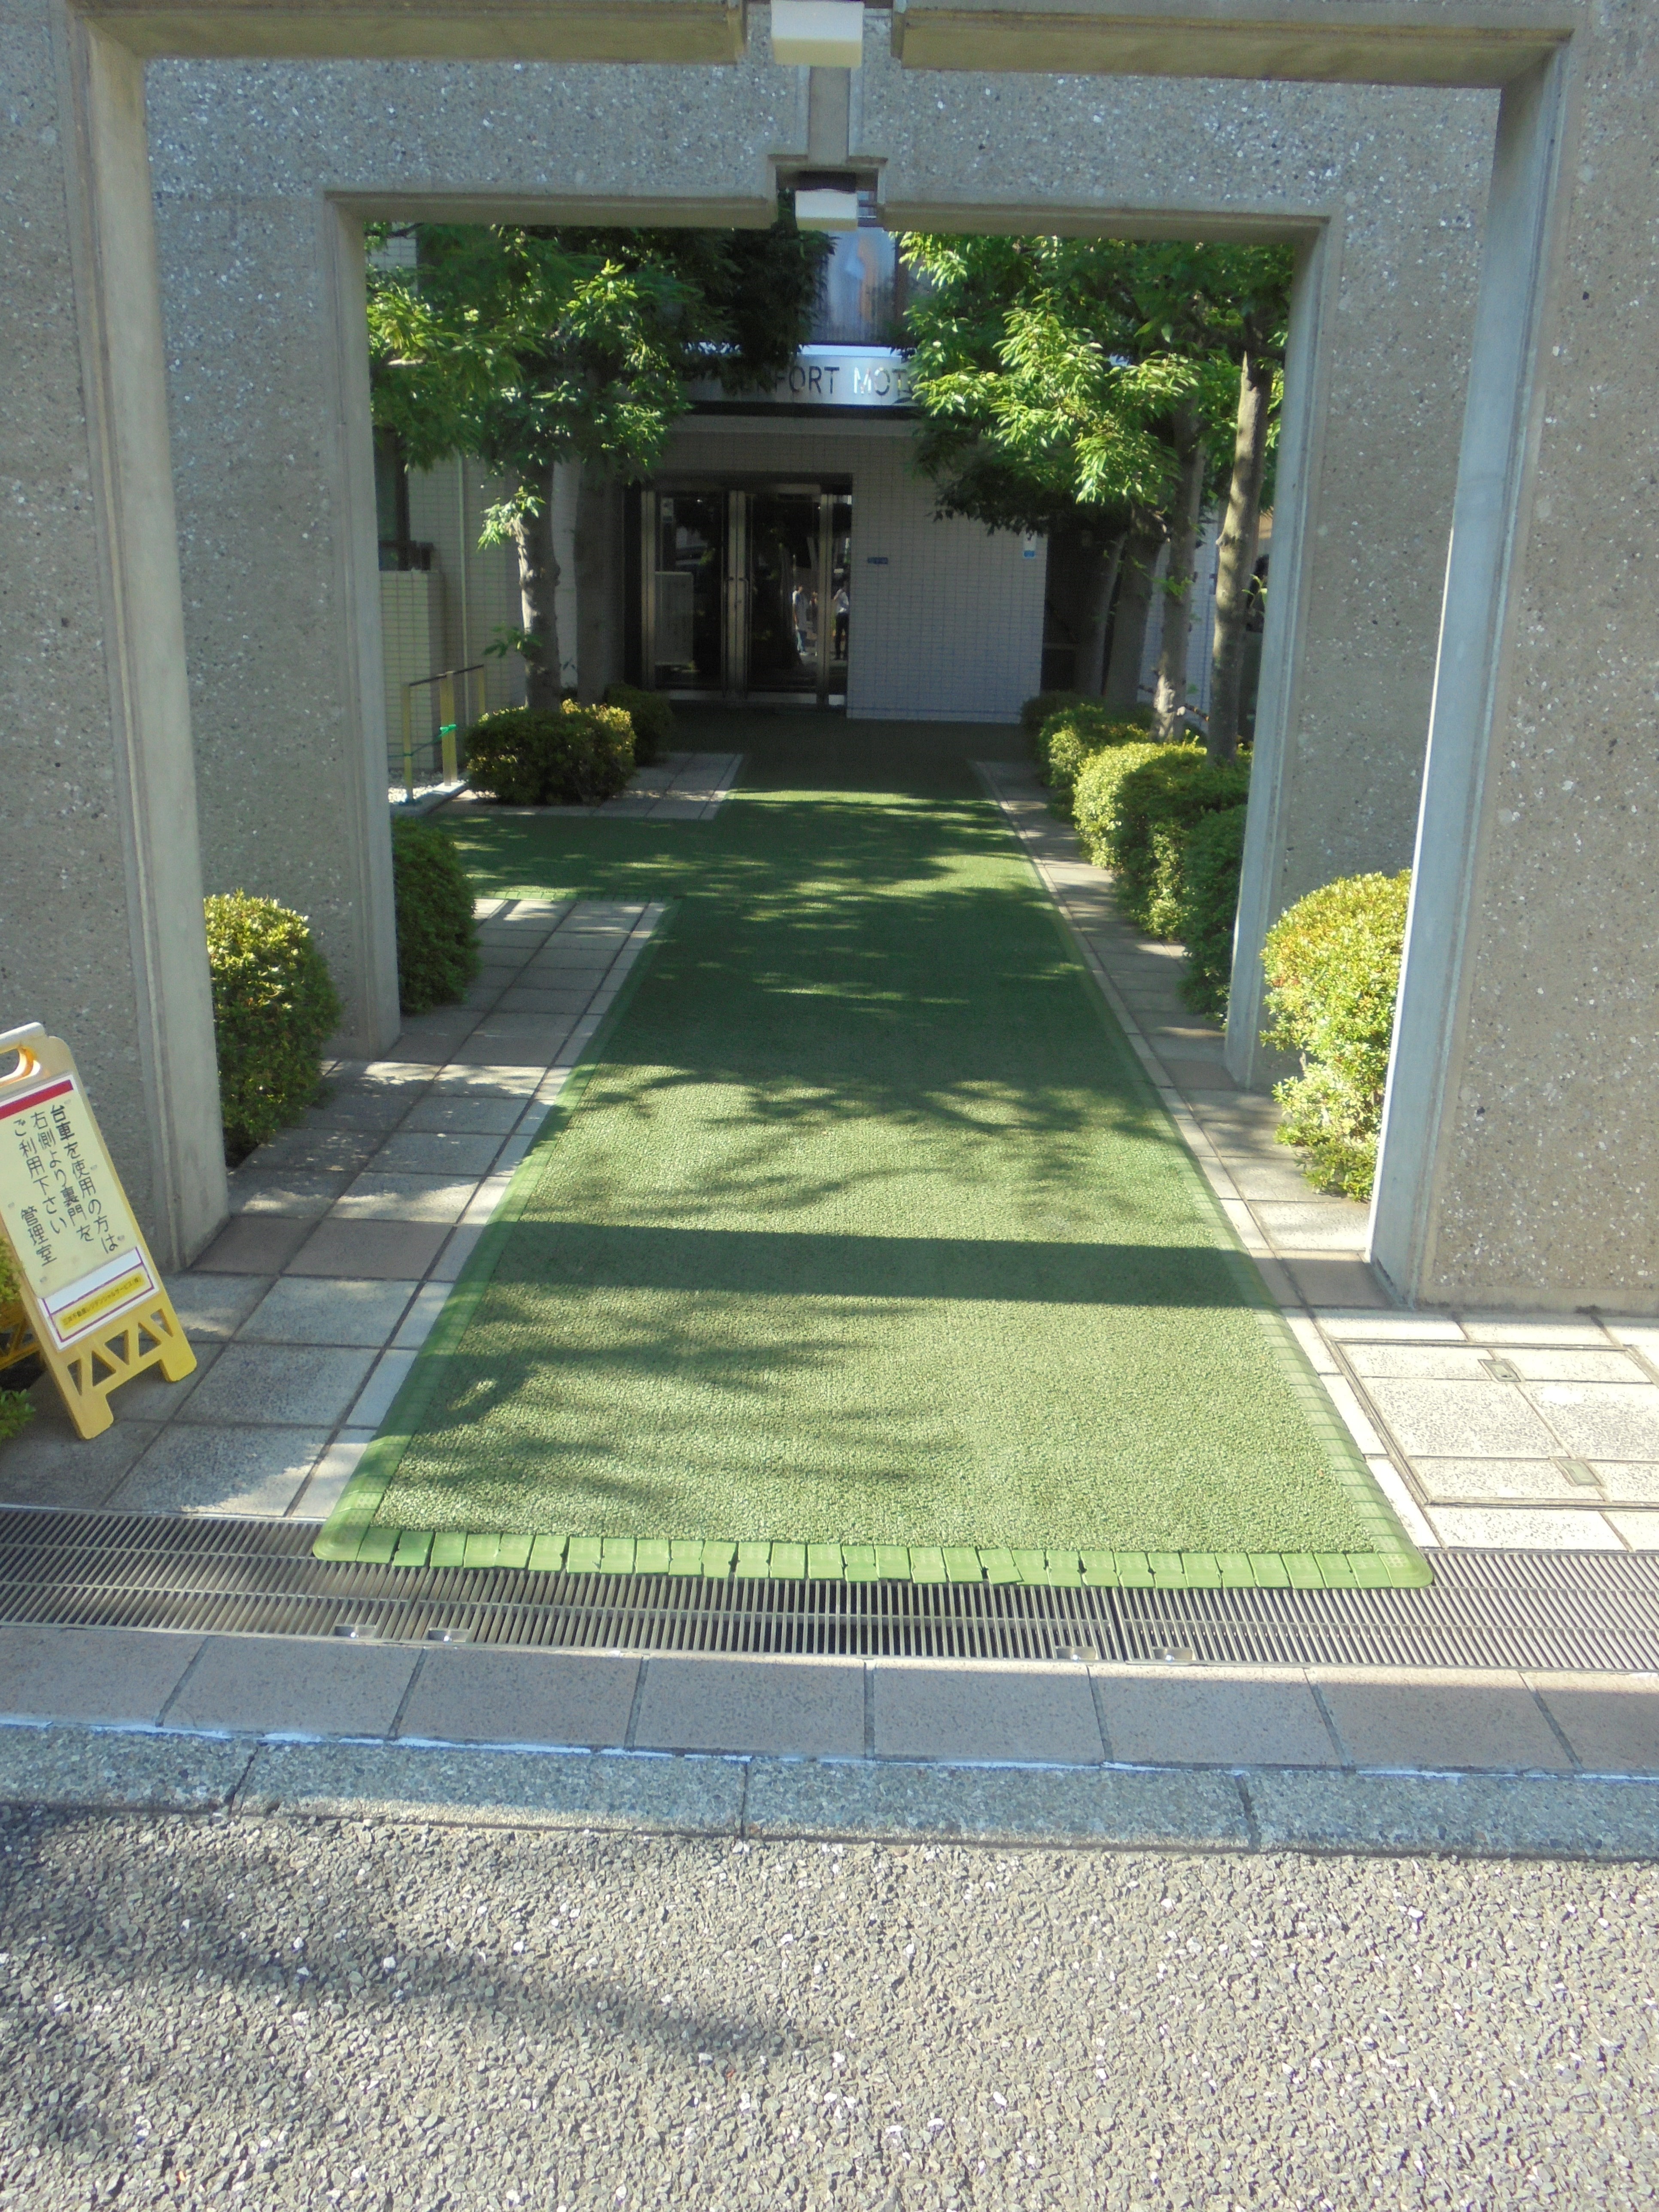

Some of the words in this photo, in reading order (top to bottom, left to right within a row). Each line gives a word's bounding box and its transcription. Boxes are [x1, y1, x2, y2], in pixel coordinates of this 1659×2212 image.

[13, 1118, 67, 1234] ご利用下さい
[21, 1206, 57, 1266] 管理室
[30, 1112, 94, 1242] 右側より裏門を
[51, 1105, 118, 1254] 台車を使用の方は
